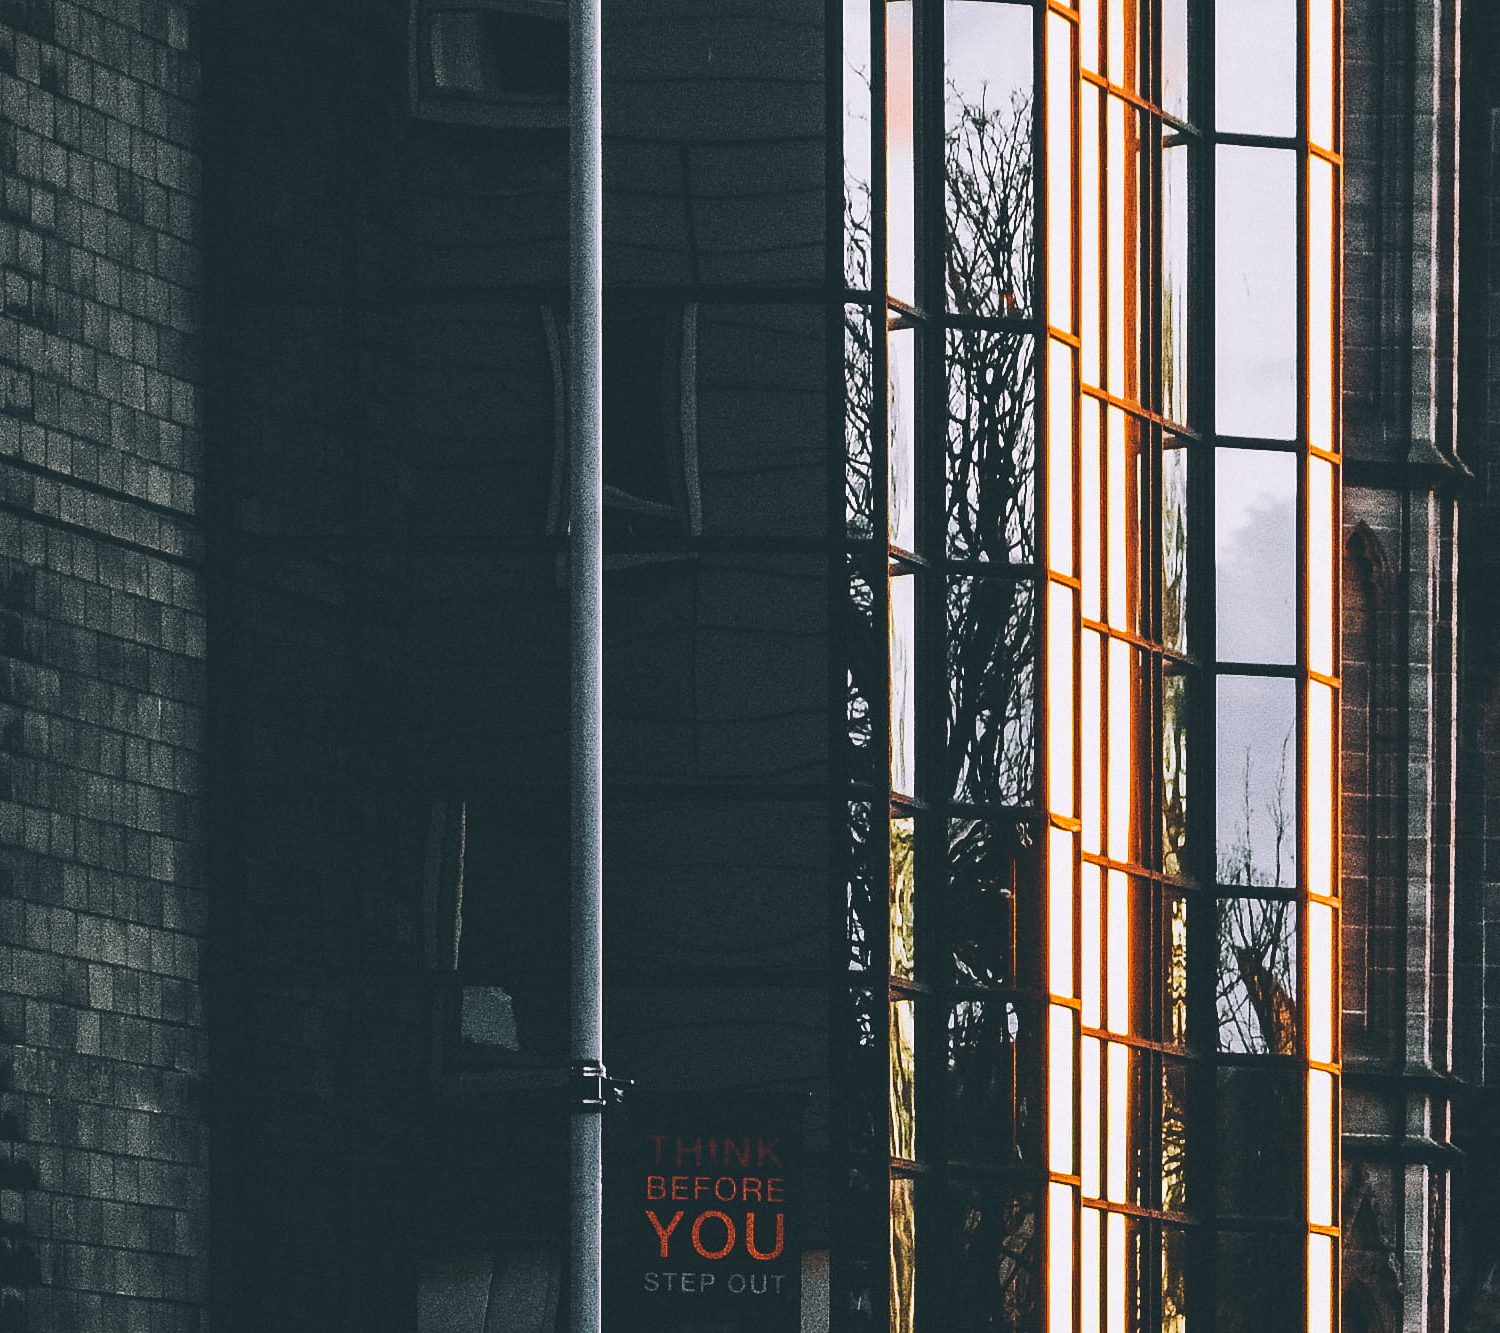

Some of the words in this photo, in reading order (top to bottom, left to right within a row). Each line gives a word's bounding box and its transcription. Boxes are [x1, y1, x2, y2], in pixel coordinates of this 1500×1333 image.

[647, 1135, 782, 1168] THINK
[647, 1175, 784, 1202] BEFORE
[645, 1210, 785, 1260] YOU
[643, 1272, 715, 1292] STEP
[728, 1273, 786, 1294] OUT
